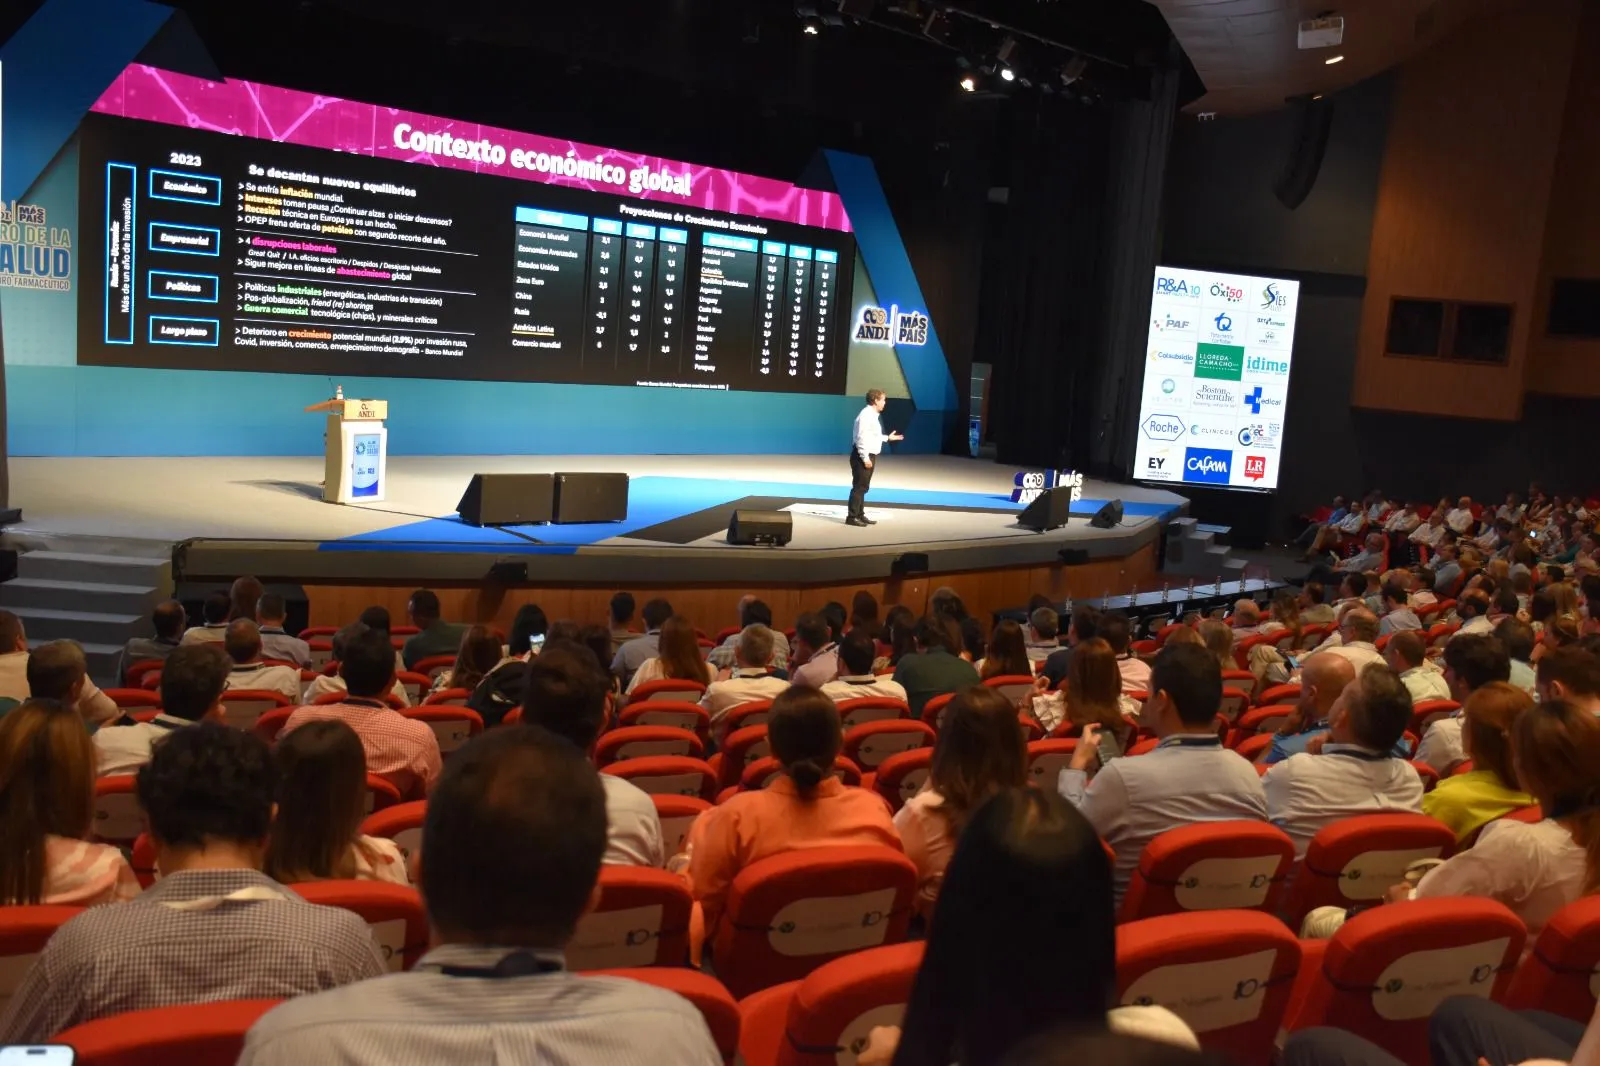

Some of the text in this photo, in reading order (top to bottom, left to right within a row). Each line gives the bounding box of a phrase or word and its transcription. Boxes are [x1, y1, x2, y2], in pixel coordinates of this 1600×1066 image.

[170, 152, 202, 167] 2023
[393, 123, 692, 196] Contexto económico global
[249, 164, 416, 197] Se decantan nuevos equilibrios
[246, 183, 256, 191] Se
[280, 186, 314, 198] inflación
[19, 205, 44, 216] MÁS
[245, 194, 282, 208] Intereses
[283, 199, 306, 208] toman
[308, 203, 329, 211] pausa
[368, 209, 385, 218] alzas
[122, 198, 132, 232] invasión
[320, 213, 344, 224] Europa
[25, 225, 70, 247] DE LA
[245, 215, 267, 224] OPEP
[268, 218, 288, 227] frena
[289, 220, 310, 230] oferta
[312, 223, 320, 231] de
[368, 231, 397, 239] segundo
[398, 234, 421, 242] recorte
[122, 243, 131, 254] de
[252, 237, 302, 249] disrupciones
[302, 242, 337, 253] laborales
[121, 255, 131, 271] año
[245, 258, 266, 268] Sigue
[268, 261, 292, 270] mejora
[392, 272, 412, 281] global
[352, 259, 378, 268] Despidos
[122, 272, 130, 282] un
[121, 284, 130, 295] de
[1157, 277, 1188, 294] R&A
[278, 285, 322, 299] industriales
[368, 292, 397, 302] industrias
[121, 295, 131, 313] Más
[311, 298, 331, 307] friend
[244, 304, 270, 313] Guerra
[272, 307, 308, 315] comercial
[311, 309, 350, 319] tecnológica
[382, 314, 414, 322] minerales
[900, 314, 927, 330] MÁS
[1166, 319, 1190, 329] PAF
[242, 327, 276, 339] Deterioro
[278, 330, 288, 340] en
[288, 330, 332, 339] crecimiento
[333, 333, 363, 344] potencial
[365, 335, 391, 346] mundial
[414, 338, 425, 348] por
[426, 338, 452, 346] invasión
[855, 325, 890, 340] ANDI
[235, 337, 257, 346] Covid,
[1158, 351, 1194, 362] Colsubsidio
[1199, 359, 1233, 368] CAMACHO
[1246, 355, 1288, 373] idime
[1202, 384, 1227, 395] Boston
[1149, 420, 1179, 434] Roche
[1148, 457, 1165, 469] EY
[1247, 459, 1263, 472] LR
